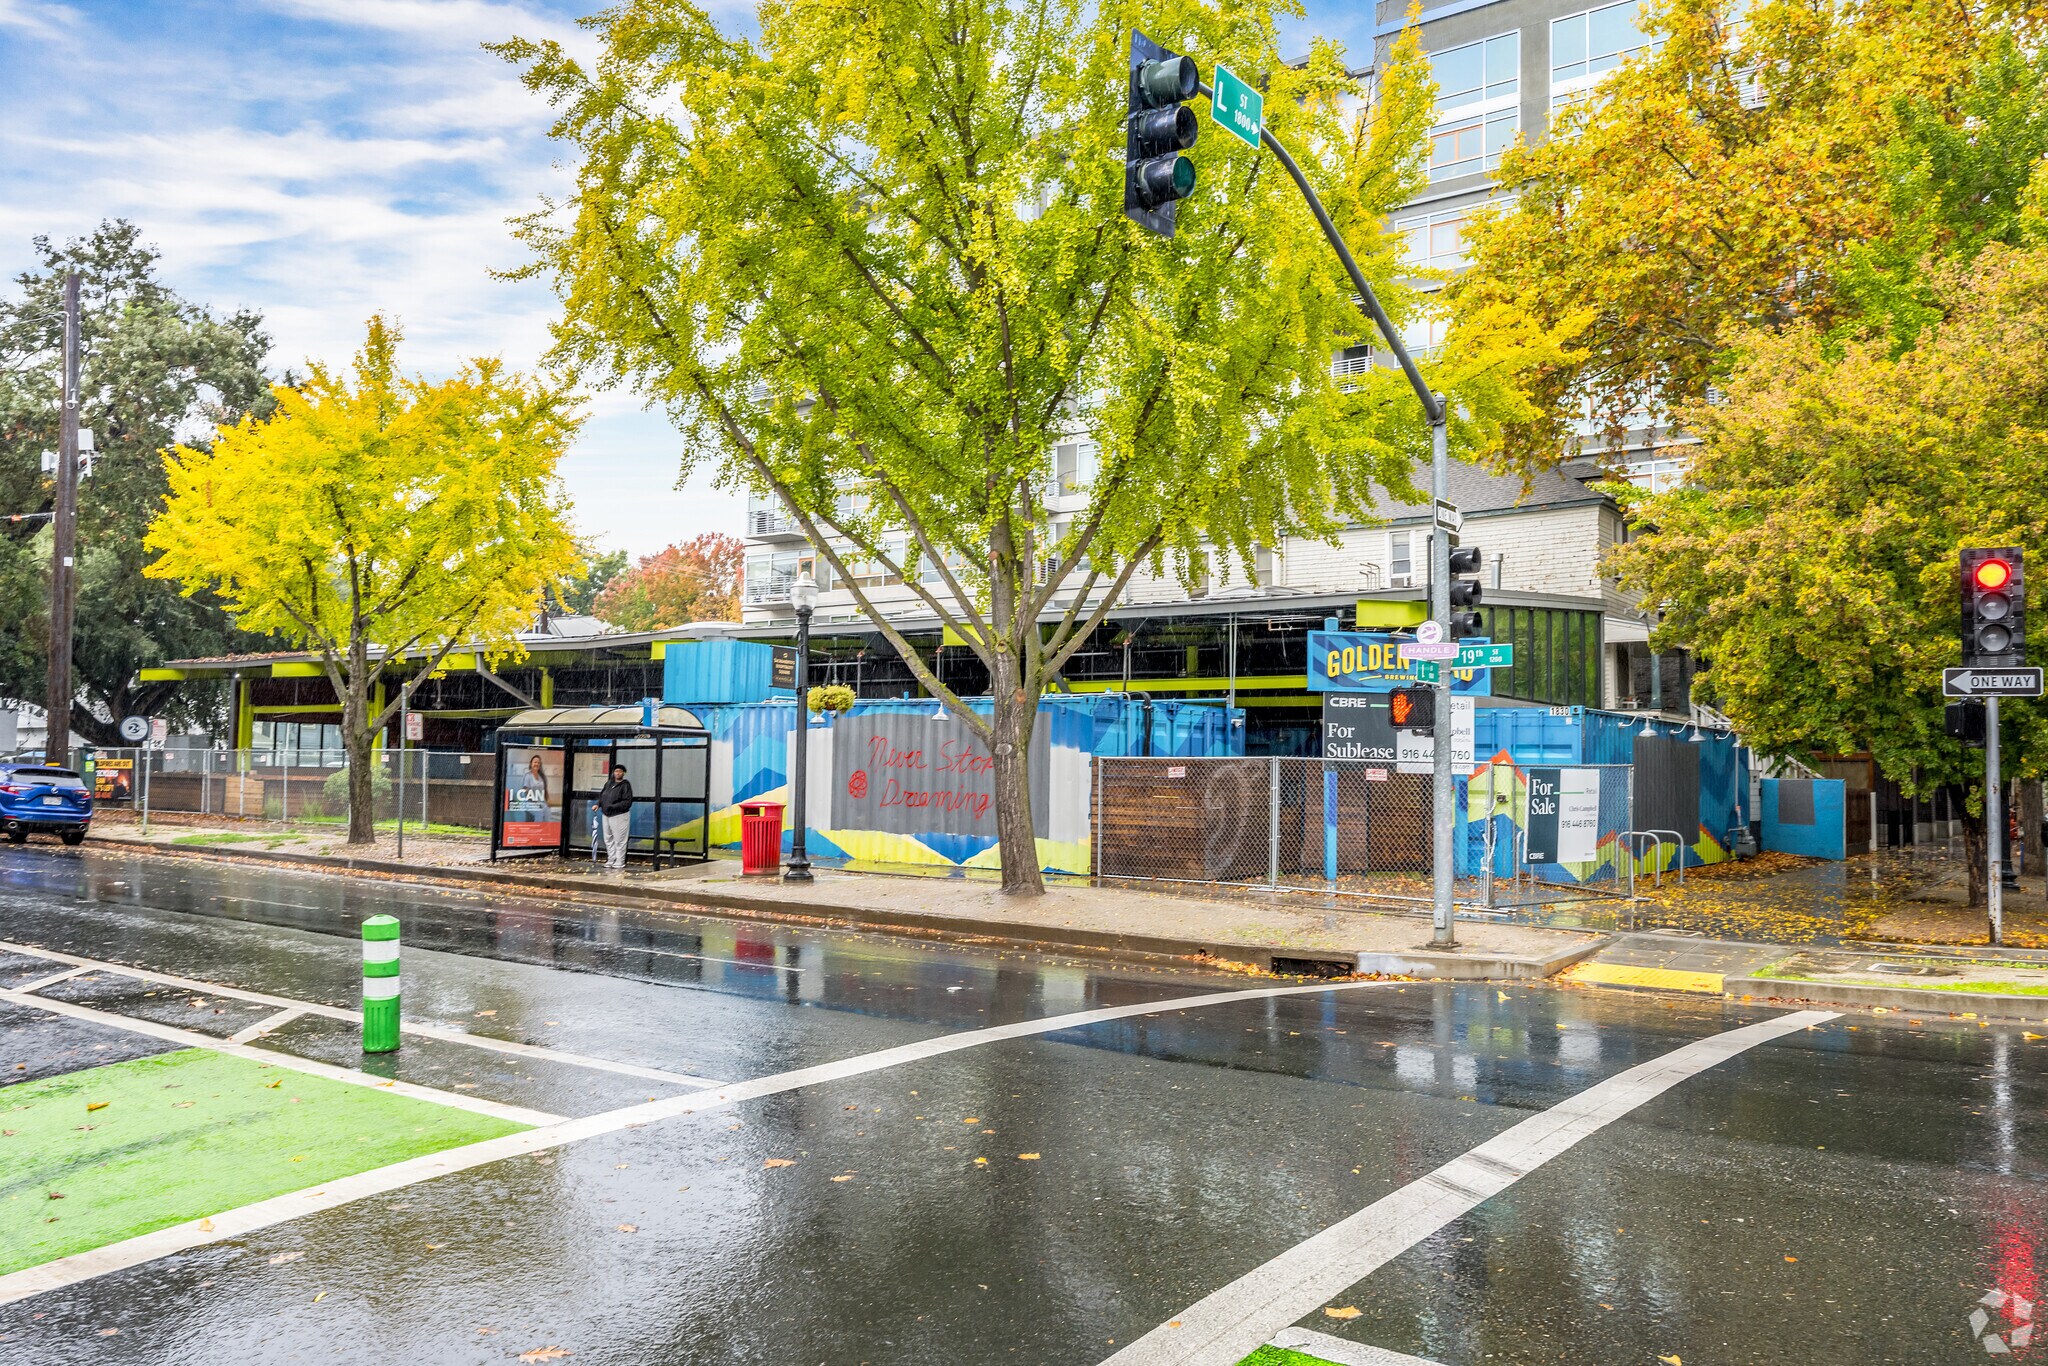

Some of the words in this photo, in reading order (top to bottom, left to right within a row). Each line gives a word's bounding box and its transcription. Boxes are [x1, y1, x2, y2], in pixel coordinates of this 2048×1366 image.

[1217, 81, 1227, 112] L
[1240, 93, 1249, 110] ST
[1234, 109, 1252, 131] 1800
[1461, 649, 1484, 664] 19th
[1971, 676, 1998, 688] ONE
[2001, 676, 2032, 687] WAY
[1329, 697, 1367, 708] CBRE
[1451, 700, 1471, 710] etail
[1551, 706, 1570, 716] 1830
[1327, 723, 1355, 738] For
[1326, 742, 1395, 759] Sublease
[1402, 749, 1420, 760] 916
[1422, 749, 1434, 760] 44
[1532, 779, 1553, 796] For
[509, 789, 515, 801] I
[517, 789, 545, 802] CAN
[1531, 798, 1556, 815] Sale
[1529, 852, 1545, 860] CBRE
